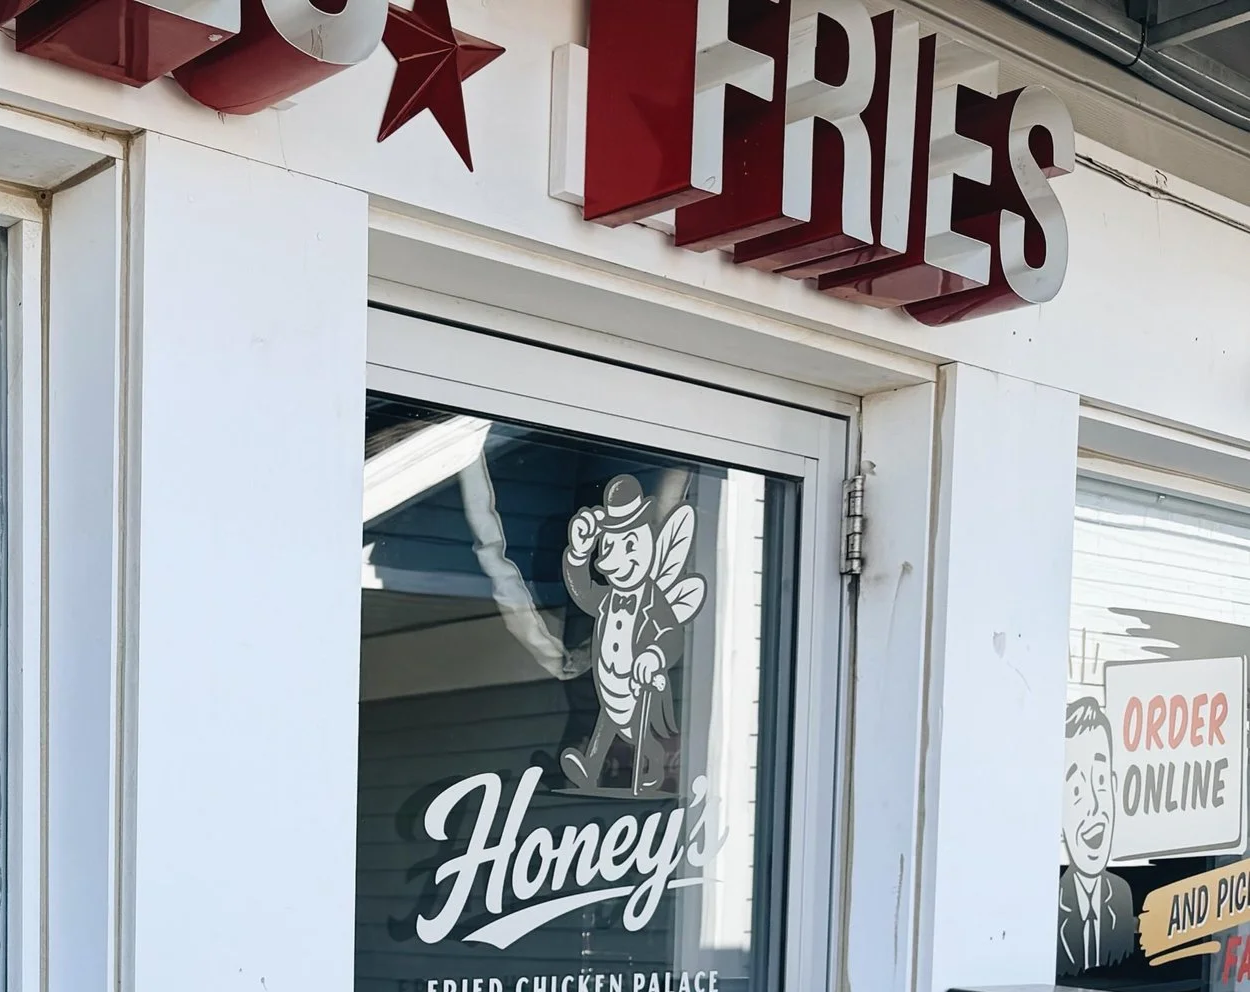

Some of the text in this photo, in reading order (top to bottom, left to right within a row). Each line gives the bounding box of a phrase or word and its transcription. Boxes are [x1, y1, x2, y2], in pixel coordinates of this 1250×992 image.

[670, 0, 1076, 308] FRIES
[1123, 692, 1228, 752] ORDER
[1123, 757, 1229, 816] ONLINE
[416, 766, 730, 946] Honey's
[1167, 870, 1250, 939] AND PIC
